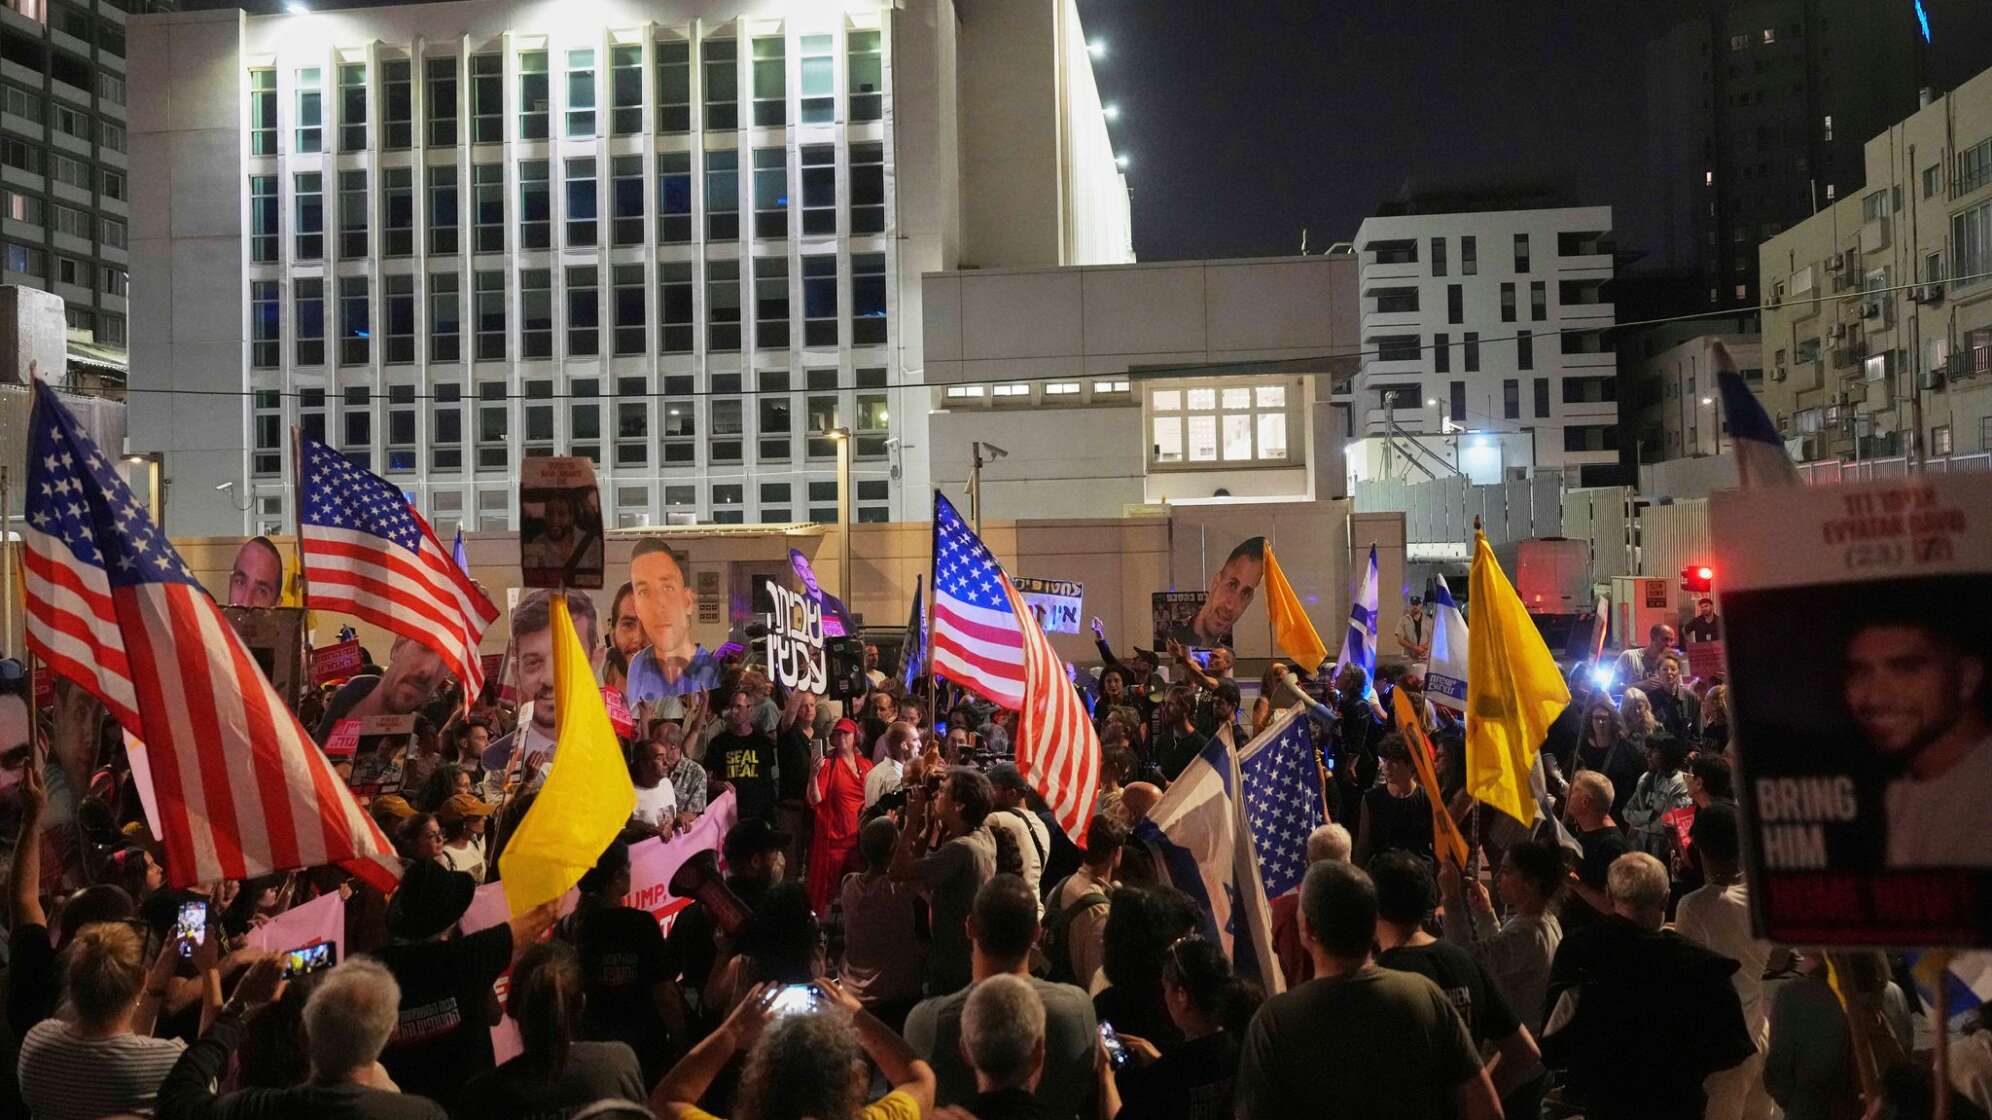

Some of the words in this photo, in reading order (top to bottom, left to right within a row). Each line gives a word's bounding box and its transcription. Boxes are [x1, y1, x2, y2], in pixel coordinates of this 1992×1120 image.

[767, 633, 828, 695] עכשיו
[1757, 777, 1857, 821] BRING
[1762, 824, 1828, 869] HIM
